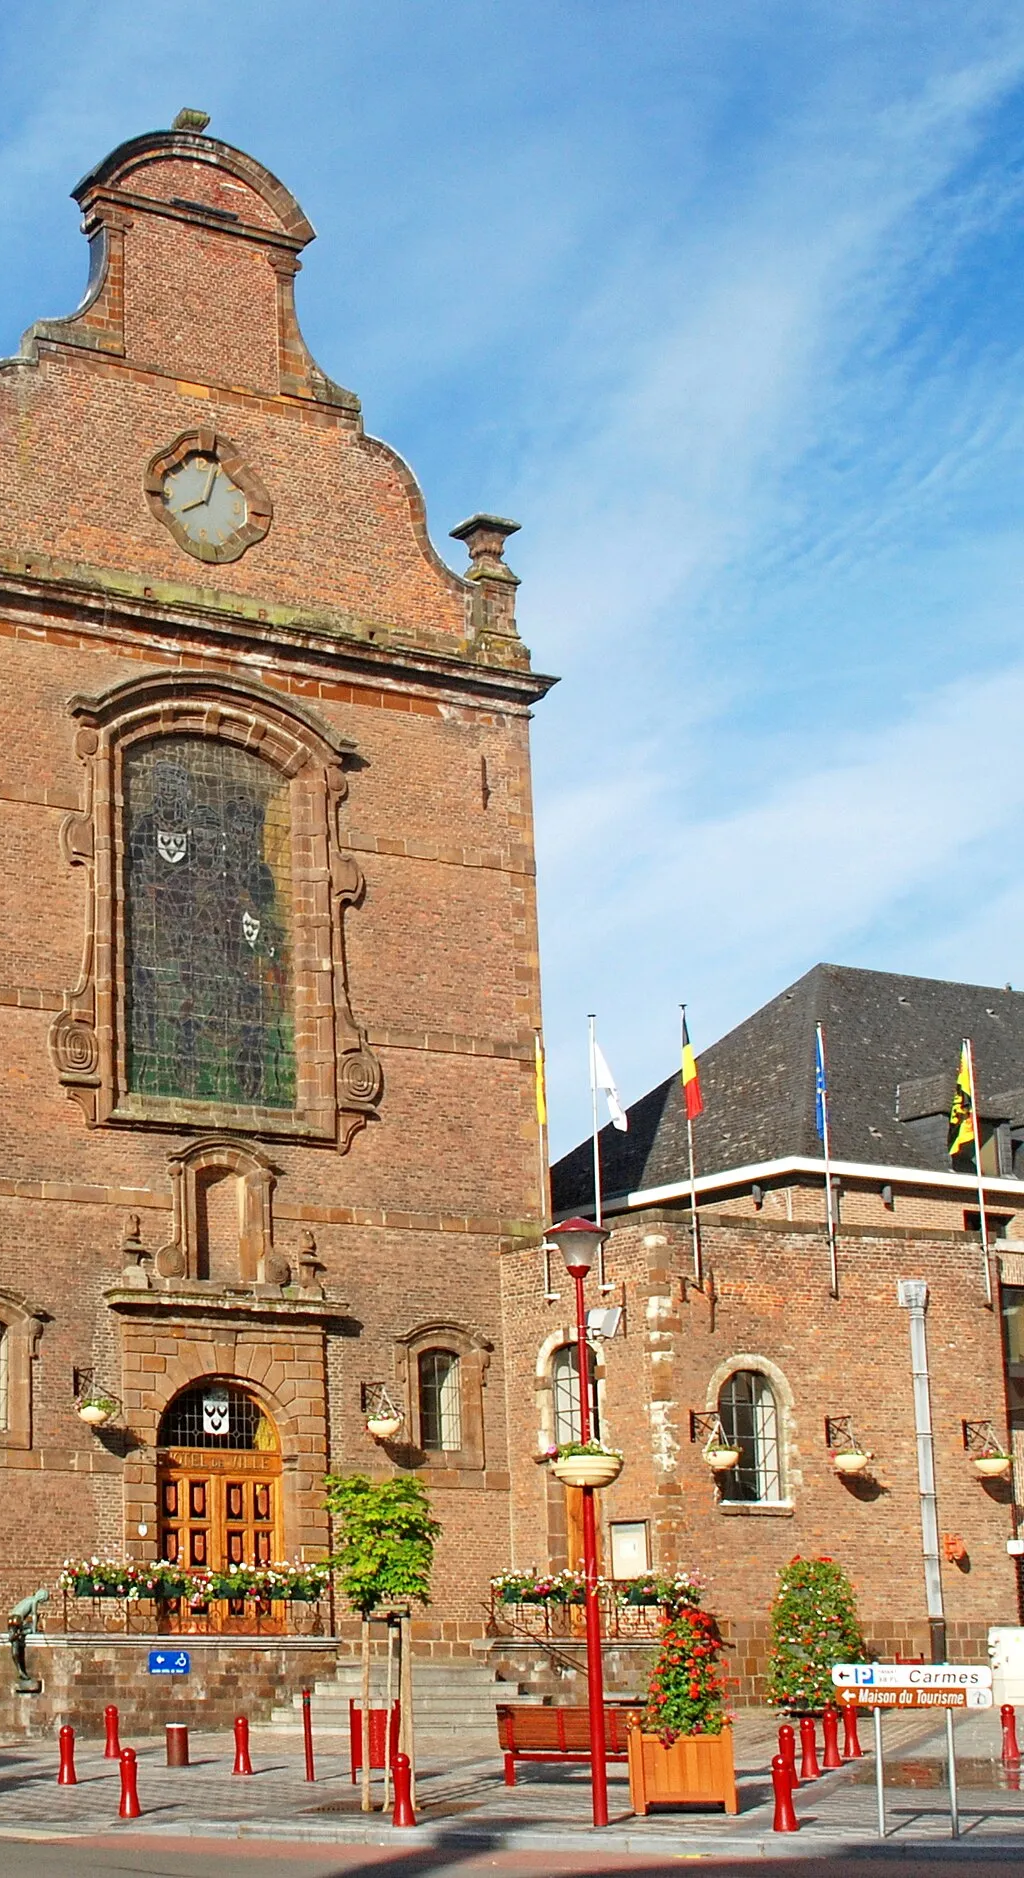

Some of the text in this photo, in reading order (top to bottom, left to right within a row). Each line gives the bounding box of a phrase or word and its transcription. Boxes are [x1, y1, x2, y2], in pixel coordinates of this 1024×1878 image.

[164, 487, 173, 498] 9
[233, 1455, 270, 1469] VILLE
[857, 1668, 979, 1684] P Carmes
[858, 1688, 964, 1705] Maison du Tourisme
